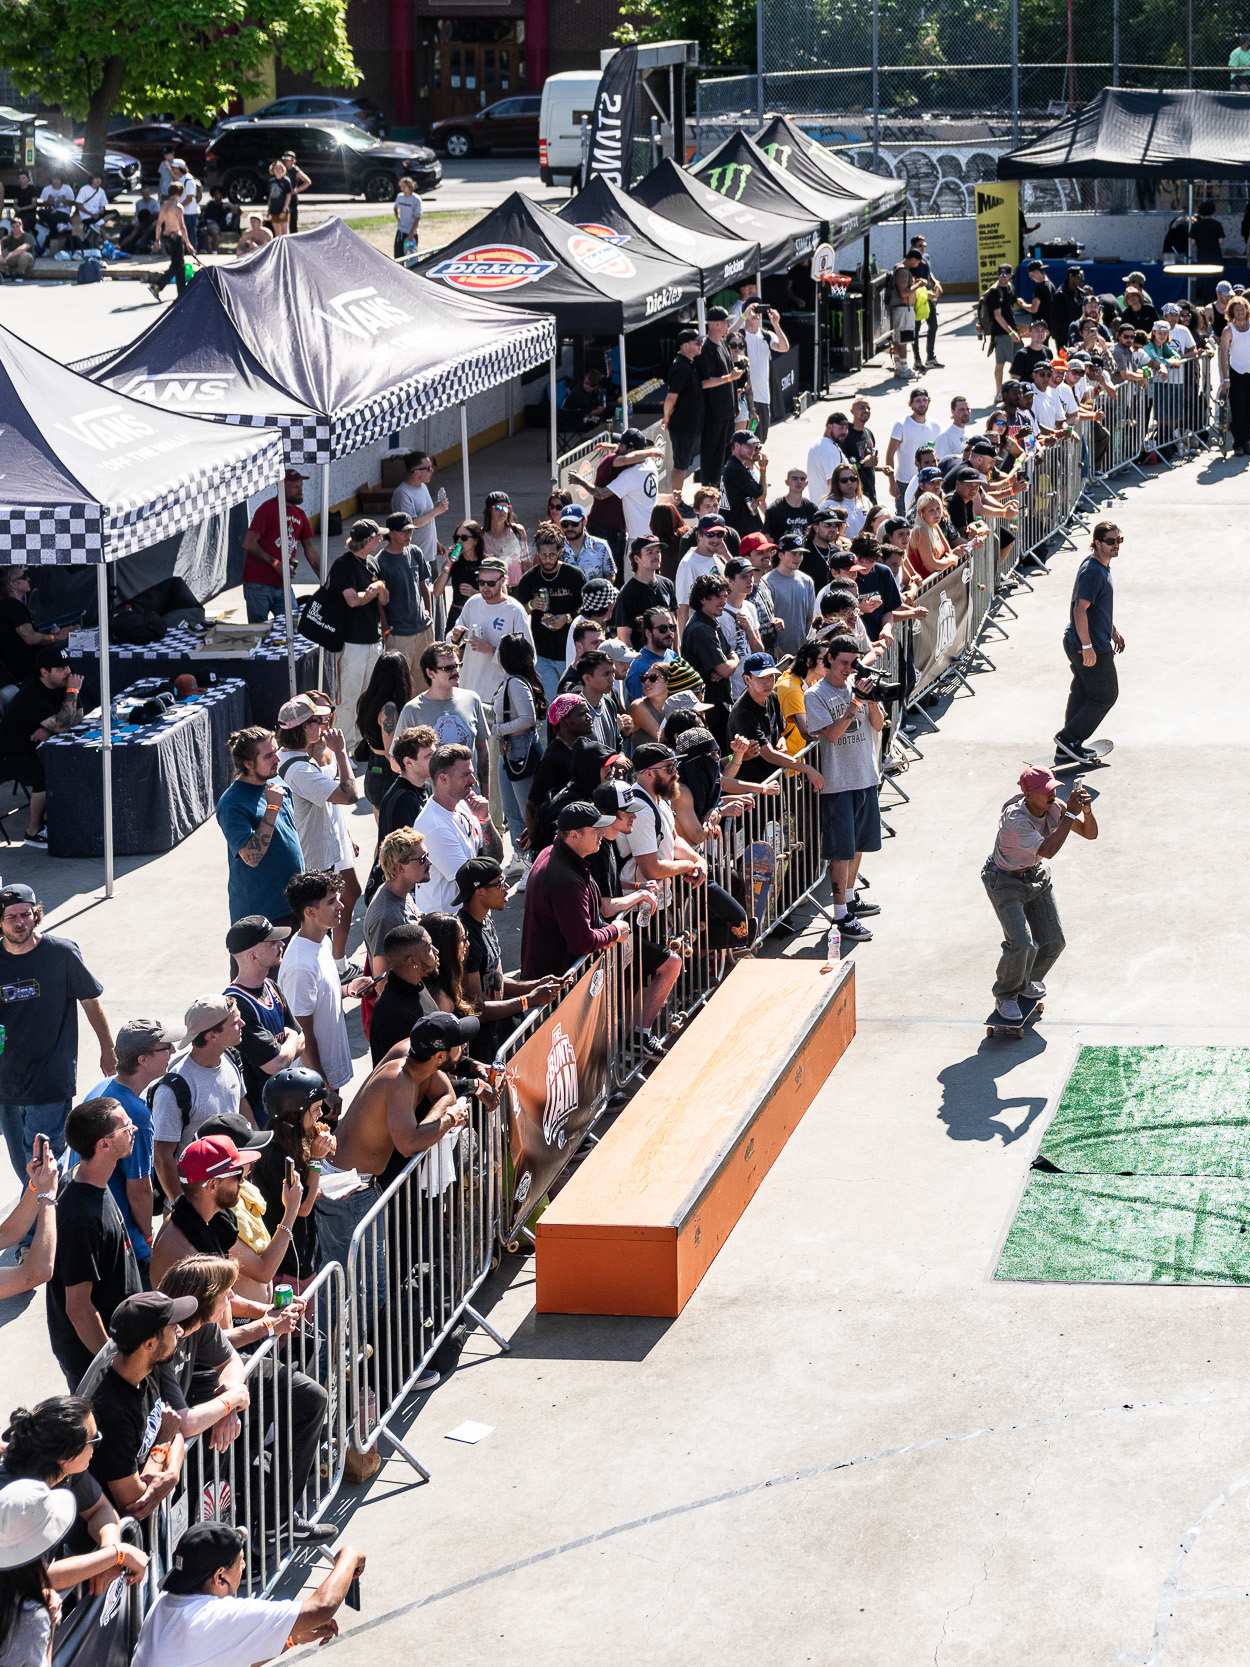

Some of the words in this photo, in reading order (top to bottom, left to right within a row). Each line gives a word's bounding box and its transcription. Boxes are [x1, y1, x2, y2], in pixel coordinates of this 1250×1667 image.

[978, 222, 1000, 230] GIANT
[313, 286, 411, 340] VANS
[645, 286, 683, 316] Dickies
[53, 404, 158, 452] VANS
[127, 446, 153, 464] THE
[543, 1063, 578, 1141] JAM
